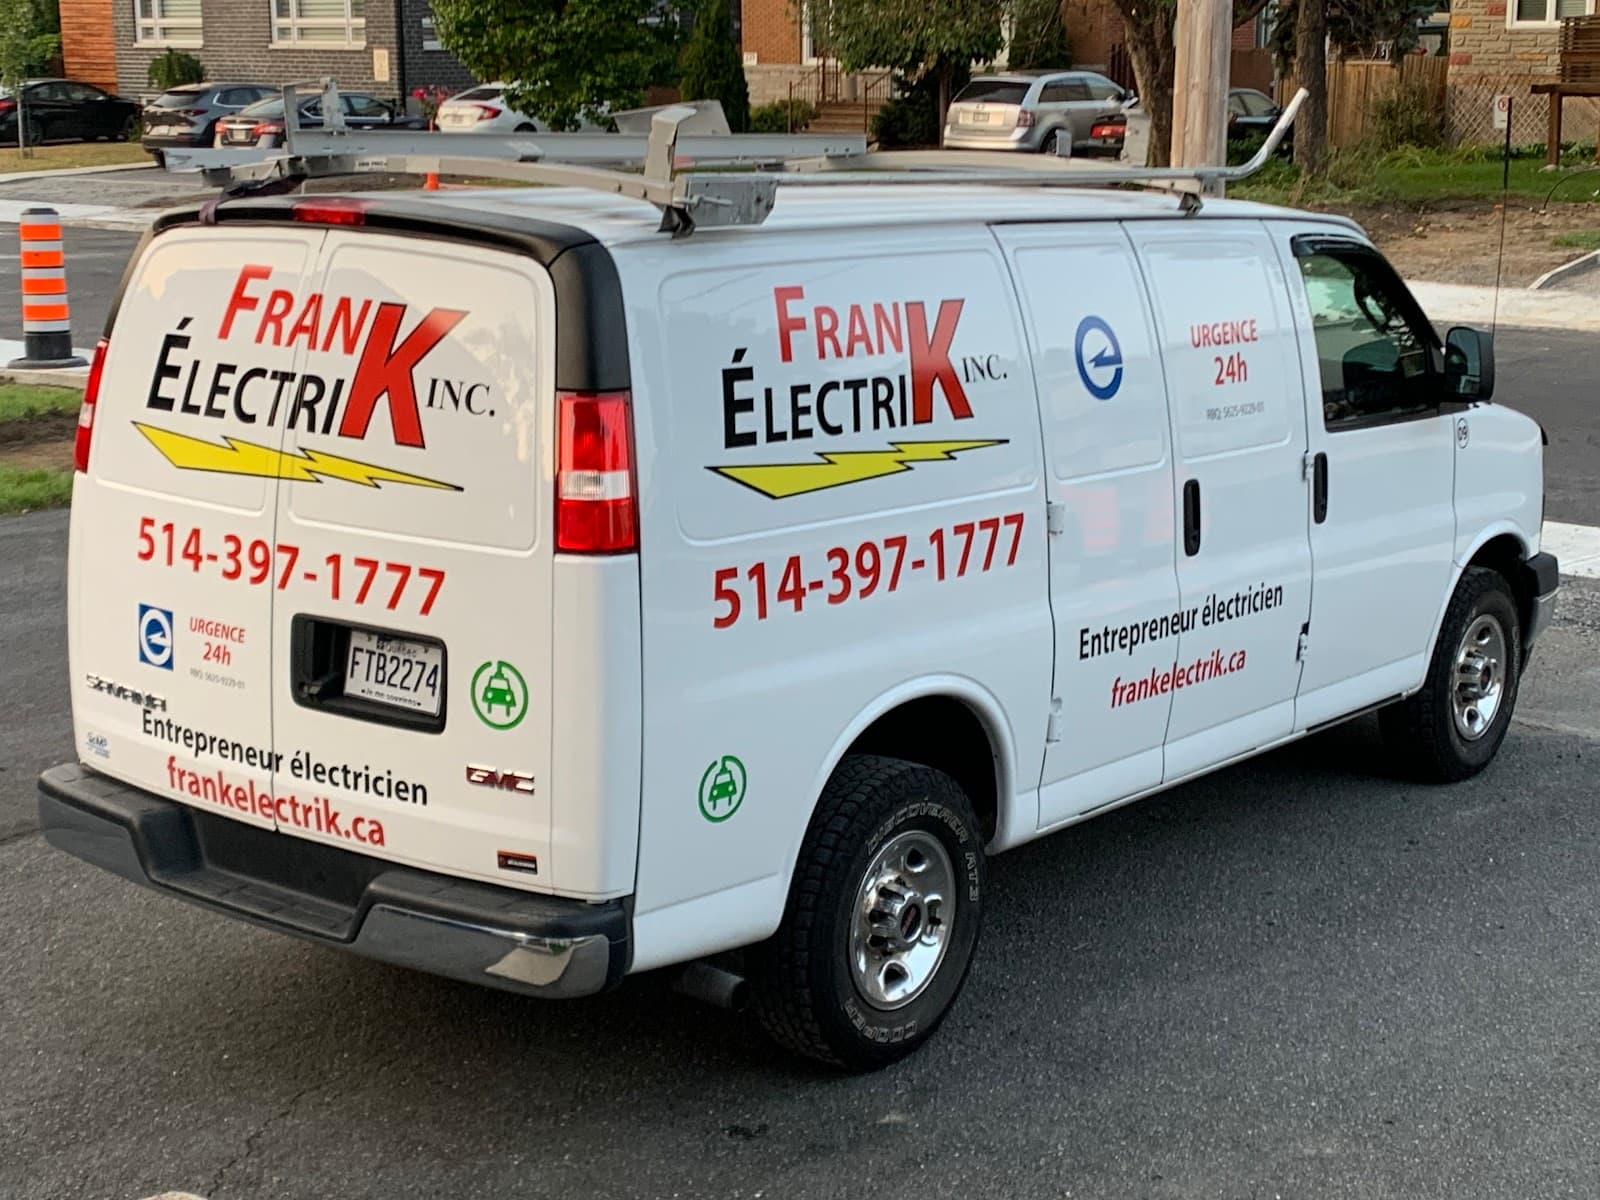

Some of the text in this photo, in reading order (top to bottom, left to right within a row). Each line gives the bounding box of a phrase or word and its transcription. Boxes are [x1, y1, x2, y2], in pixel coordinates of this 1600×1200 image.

[1191, 319, 1258, 348] URGENCE
[962, 354, 1007, 383] INC.
[1214, 351, 1247, 385] 24h
[427, 378, 495, 417] INC.
[137, 516, 445, 616] 514-397-1777
[714, 512, 1024, 629] 514-397-1777
[189, 616, 245, 643] URGENCE
[1079, 583, 1283, 660] Entrepreneur électricien
[203, 642, 231, 666] 24h
[350, 646, 439, 698] FTB2274
[1111, 647, 1246, 708] frankelectrik.ca
[142, 709, 283, 774] Entrepreneur
[290, 750, 428, 806] électricien
[466, 763, 535, 795] GMC
[167, 756, 385, 847] frankelectrik.ca
